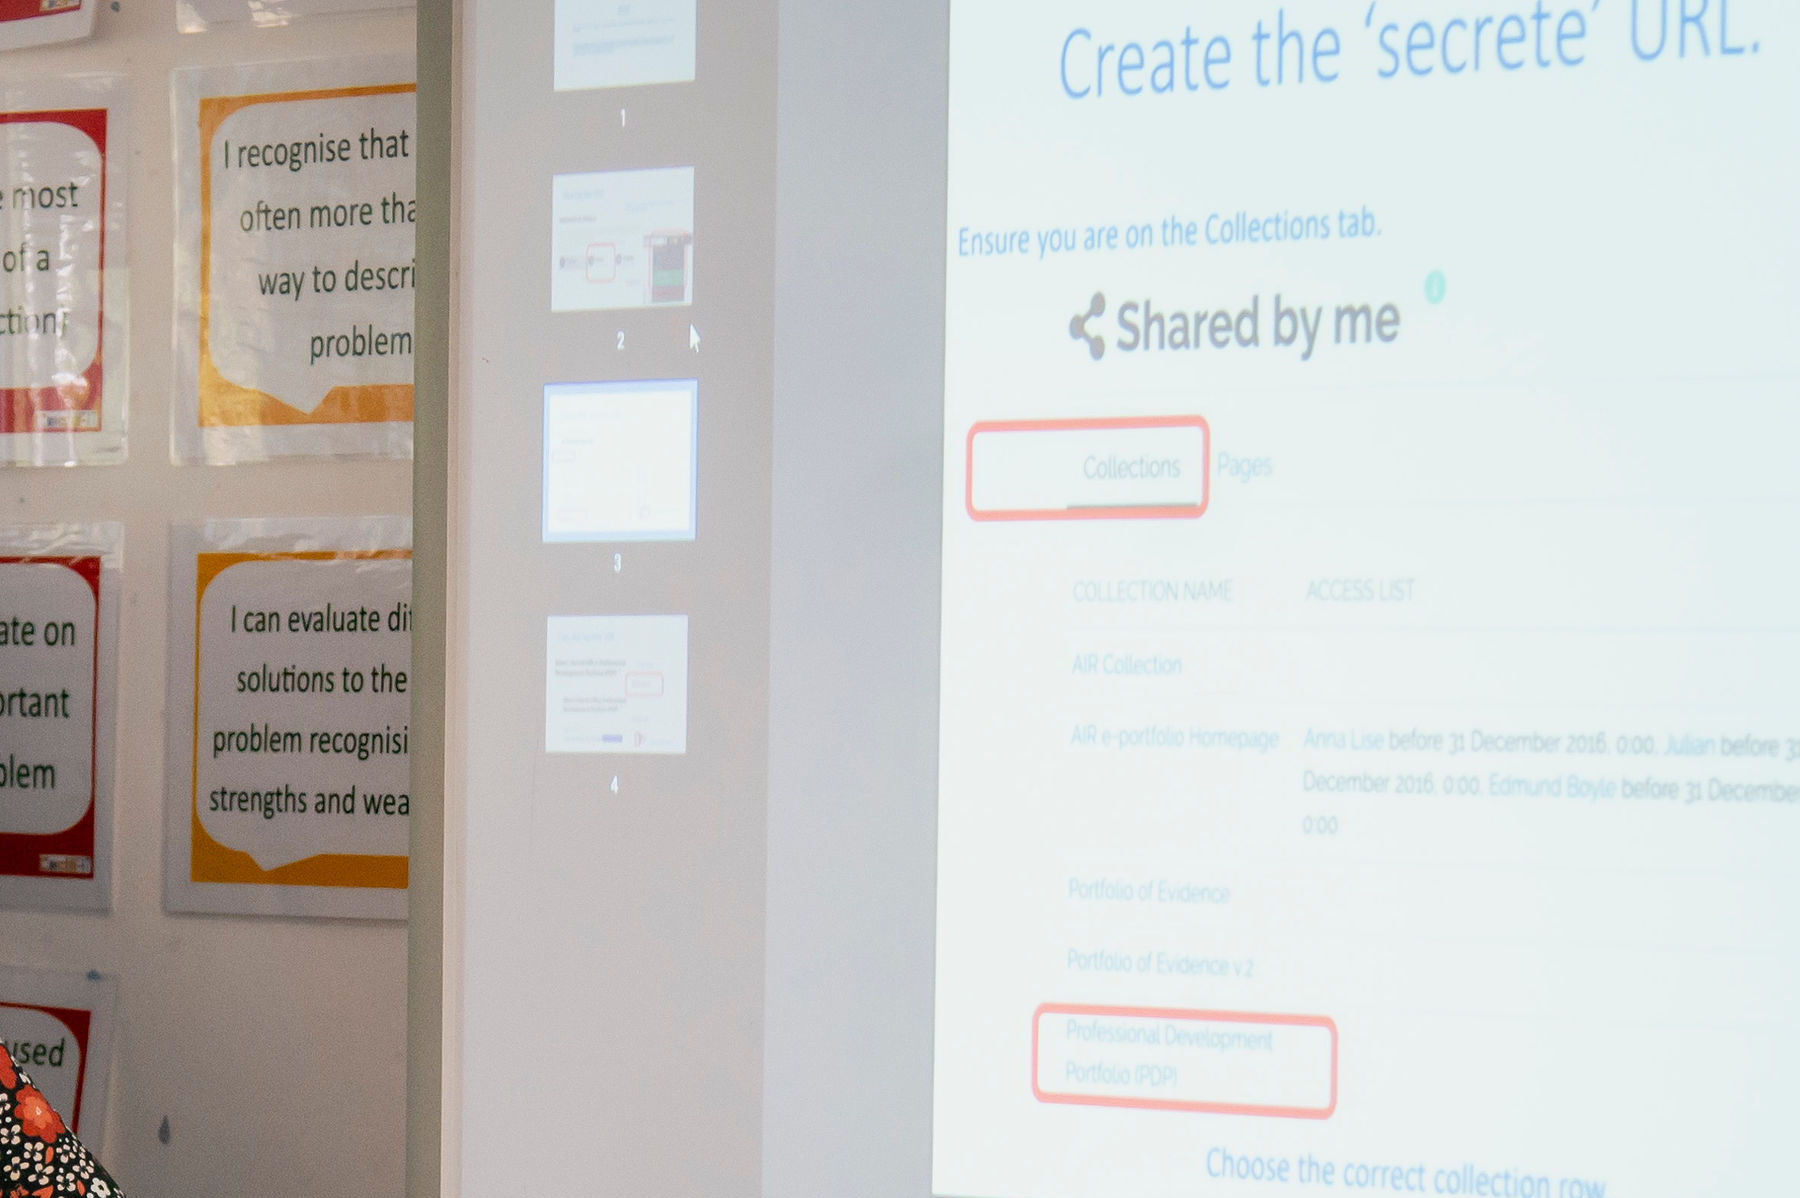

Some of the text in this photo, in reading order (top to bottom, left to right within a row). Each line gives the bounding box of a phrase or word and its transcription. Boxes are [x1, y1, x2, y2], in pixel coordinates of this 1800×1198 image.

[1060, 24, 1232, 101] Create
[1251, 7, 1342, 85] the
[1628, 0, 1762, 62] URL.
[619, 108, 627, 127] 1
[224, 127, 409, 173] I recognise that
[12, 182, 79, 209] most
[240, 200, 301, 232] often
[310, 202, 373, 229] more
[958, 204, 1383, 261] Ensure you are on the Collections tab.
[2, 241, 29, 273] of
[36, 249, 50, 272] a
[258, 272, 305, 301] way
[312, 265, 337, 293] to
[616, 331, 626, 351] 2
[1116, 292, 1401, 362] Shared by me
[310, 323, 412, 366] problem
[1082, 449, 1274, 485] Collections Pages
[613, 552, 622, 574] 3
[1072, 577, 1234, 603] COLLECTION NAME
[1305, 577, 1416, 602] ACCESS LIST
[231, 605, 236, 633] I
[243, 611, 281, 633] can
[288, 602, 380, 633] evaluate
[44, 620, 76, 647] on
[236, 663, 408, 694] solutions to the
[1072, 653, 1183, 677] AIR Collection
[213, 722, 409, 761] problem recognisi
[1071, 723, 1281, 757] AIR e-portfolio Homepage
[1303, 727, 1347, 751] Anna
[1350, 728, 1385, 751] Lise
[1388, 726, 1444, 752] before
[1448, 732, 1467, 757] 31
[1471, 729, 1561, 754] December
[1720, 730, 1780, 757] before
[608, 775, 619, 794] 4
[1303, 769, 1391, 794] December
[1488, 772, 1562, 798] Edmund
[1621, 775, 1680, 800] before
[1684, 781, 1702, 806] 31
[209, 783, 307, 820] strengths
[314, 784, 356, 815] and
[1068, 876, 1231, 904] Portfolio of Evidence
[1066, 947, 1133, 973] Portfolio
[1136, 951, 1153, 972] of
[1156, 951, 1230, 977] Evidence
[1066, 1018, 1274, 1053] Professional Development
[1065, 1060, 1178, 1089] Portfolio (PDP)
[1206, 1146, 1291, 1183] Choose
[1297, 1152, 1337, 1187] the
[1343, 1158, 1426, 1193] correct
